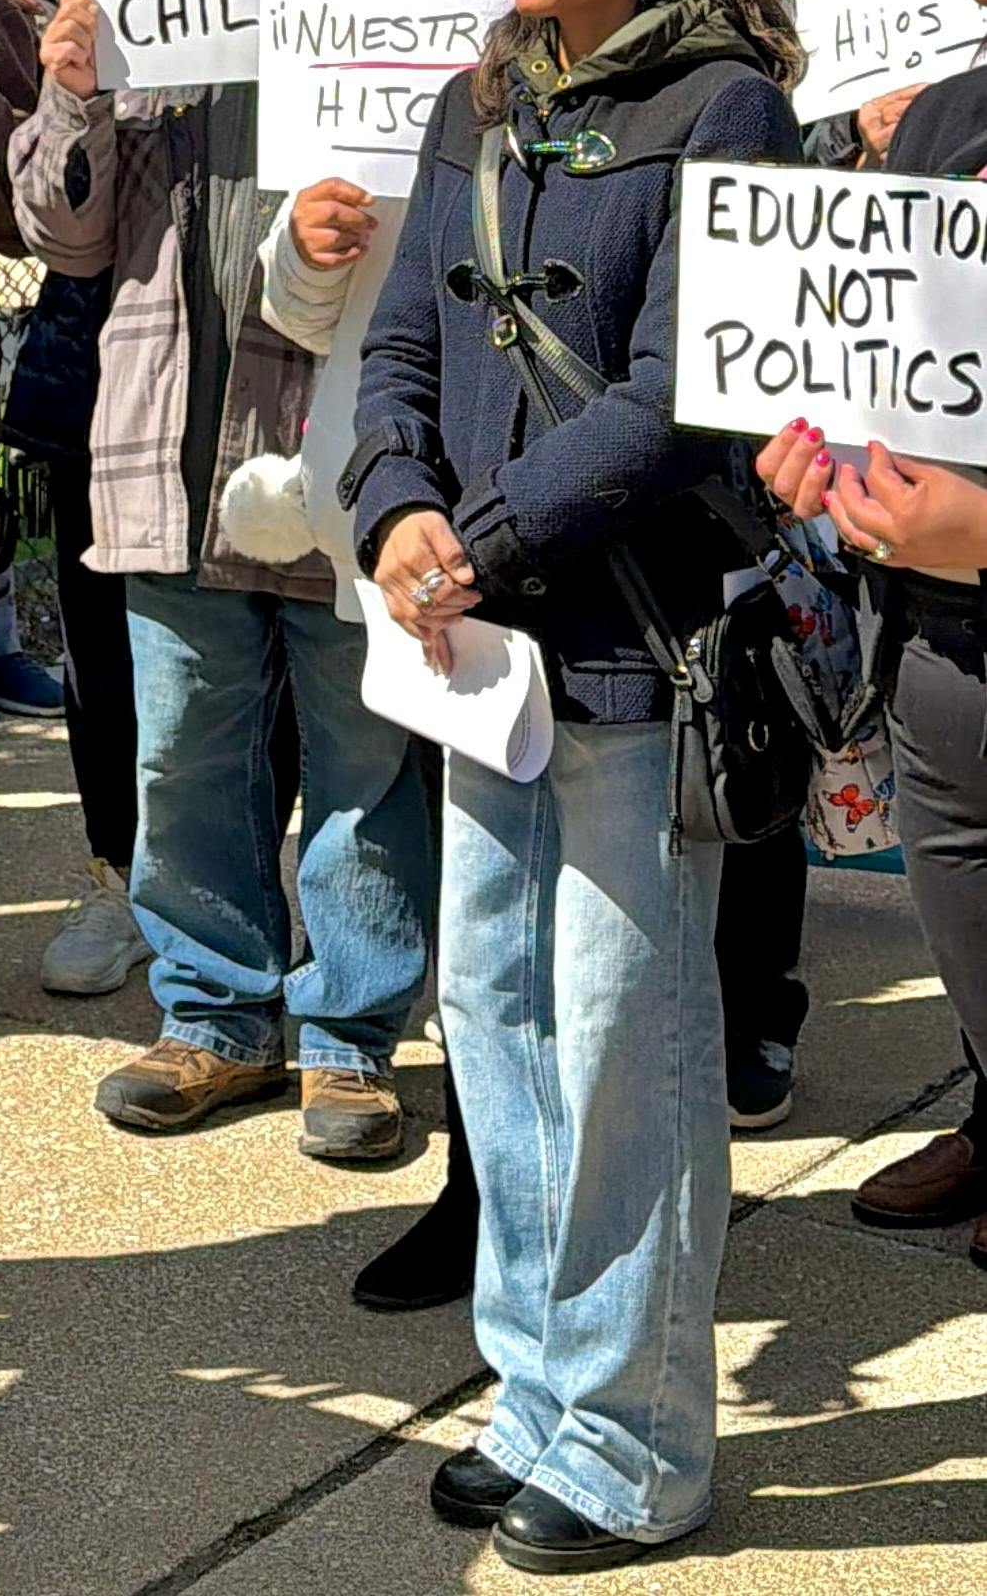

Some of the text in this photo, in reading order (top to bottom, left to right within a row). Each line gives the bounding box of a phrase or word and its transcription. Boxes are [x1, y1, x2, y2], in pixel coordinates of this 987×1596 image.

[836, 3, 941, 62] Hijos
[317, 79, 438, 133] HIJO
[706, 177, 987, 264] EDUCATIO
[795, 263, 918, 328] NOT
[704, 320, 984, 417] POLITICS
